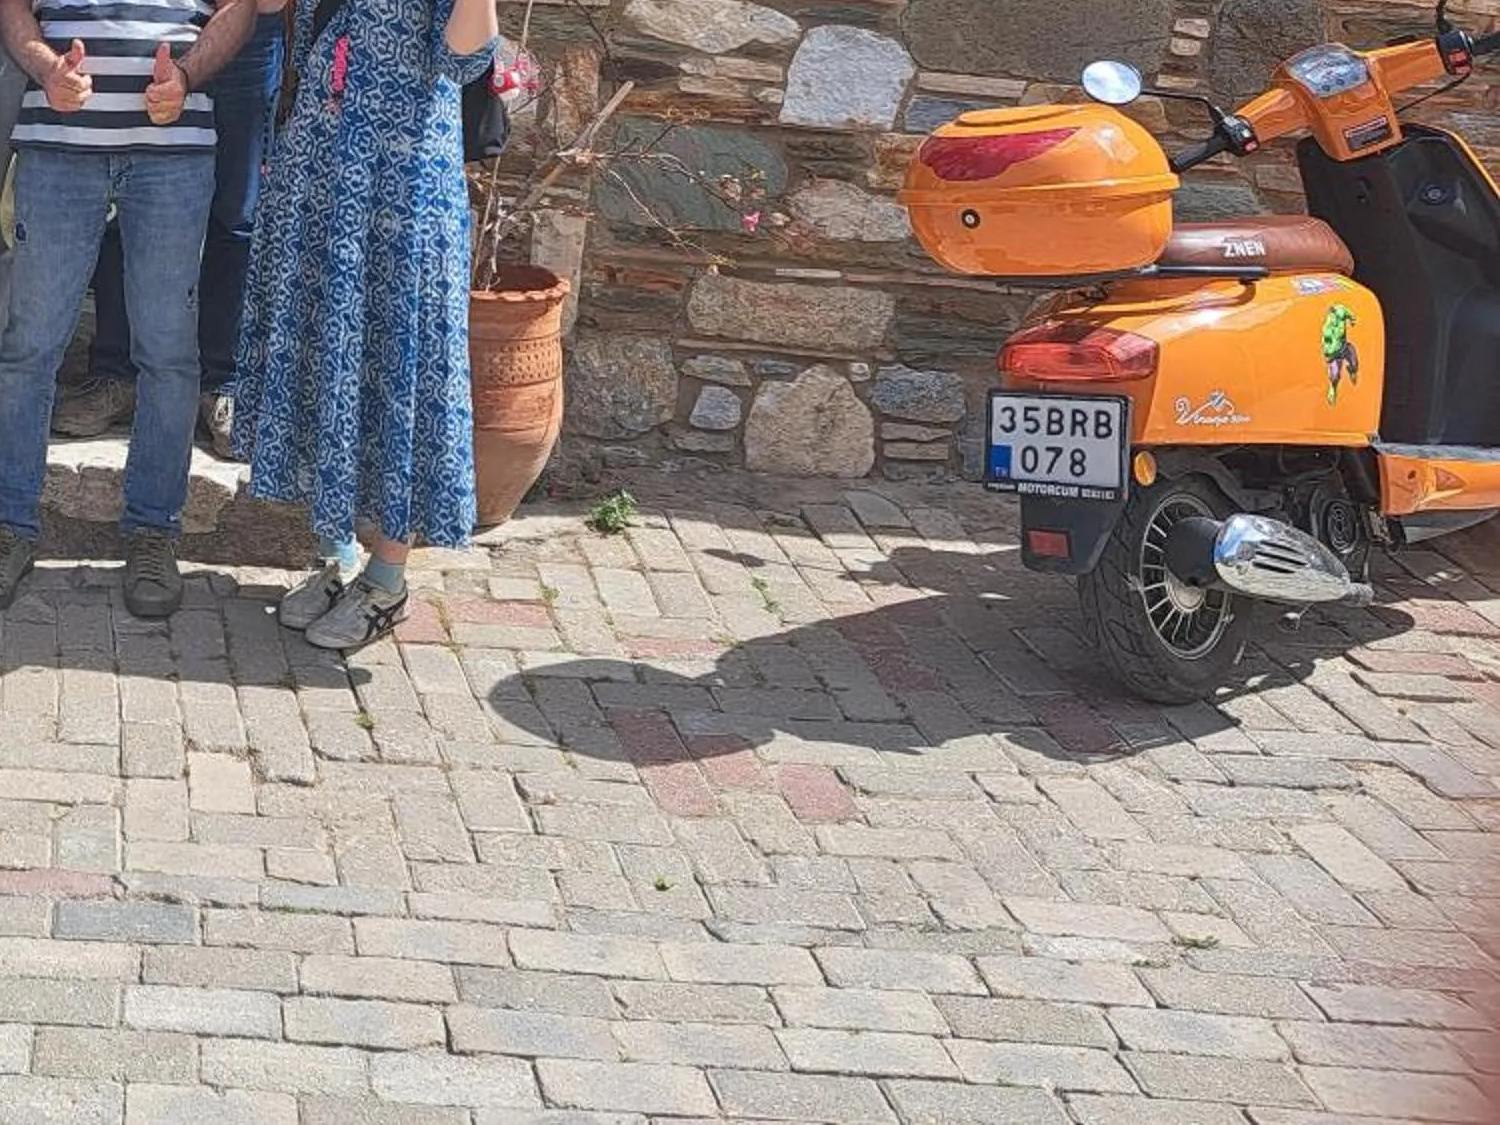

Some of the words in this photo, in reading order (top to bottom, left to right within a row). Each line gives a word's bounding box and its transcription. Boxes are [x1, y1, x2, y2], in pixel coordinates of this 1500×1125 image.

[1223, 241, 1267, 258] ZNEN
[999, 405, 1113, 440] 35BRB
[1020, 445, 1087, 478] 078
